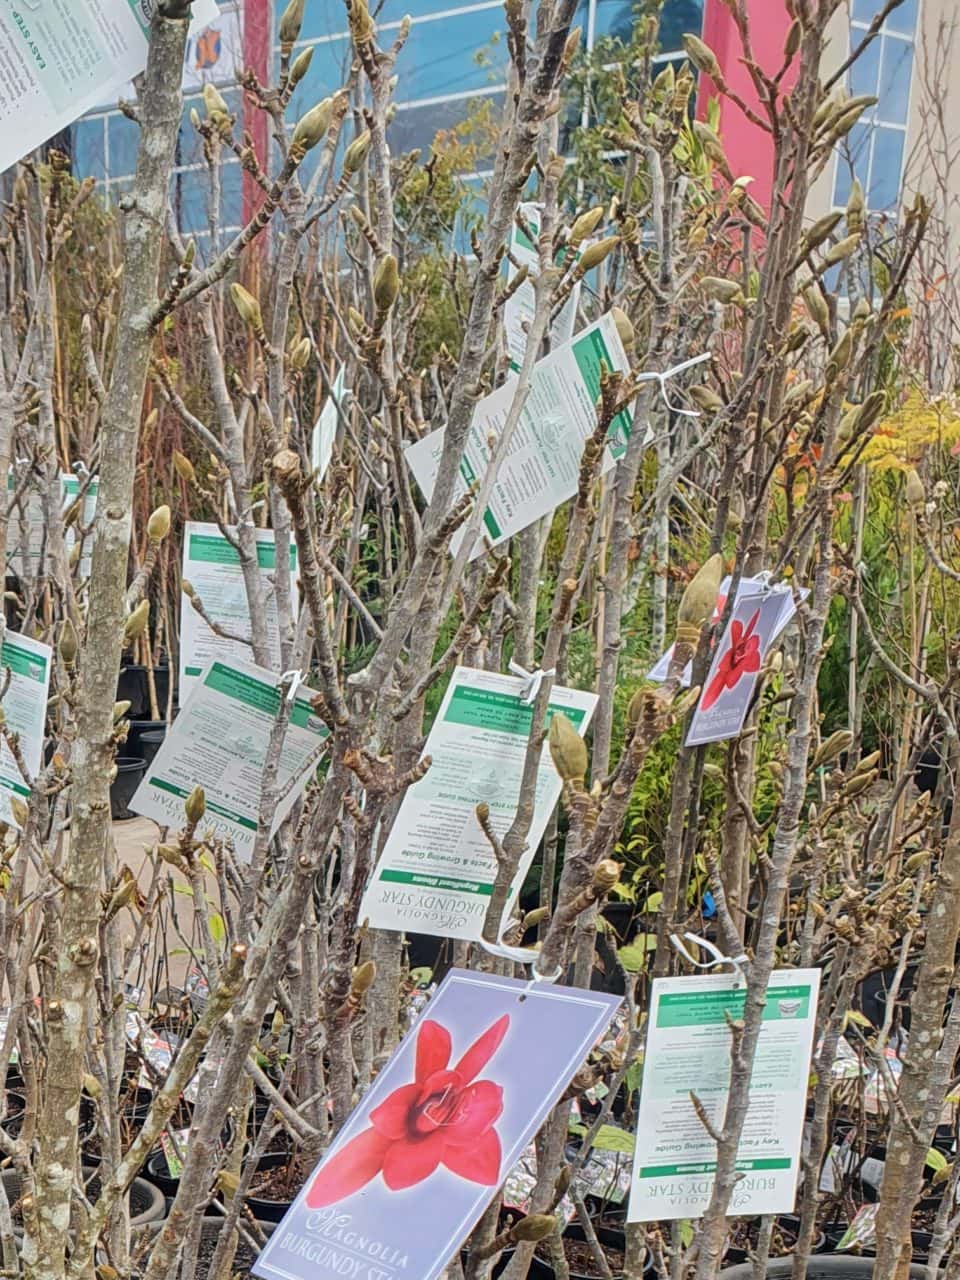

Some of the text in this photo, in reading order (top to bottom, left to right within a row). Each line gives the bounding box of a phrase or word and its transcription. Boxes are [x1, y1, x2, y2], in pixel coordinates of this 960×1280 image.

[11, 9, 31, 39] STEP
[26, 39, 48, 70] EASY
[401, 850, 425, 859] Guide
[426, 851, 459, 864] Growing
[470, 858, 491, 867] Facts
[382, 890, 414, 905] STAR
[655, 1144, 681, 1152] Guide
[649, 1184, 684, 1197] STAR
